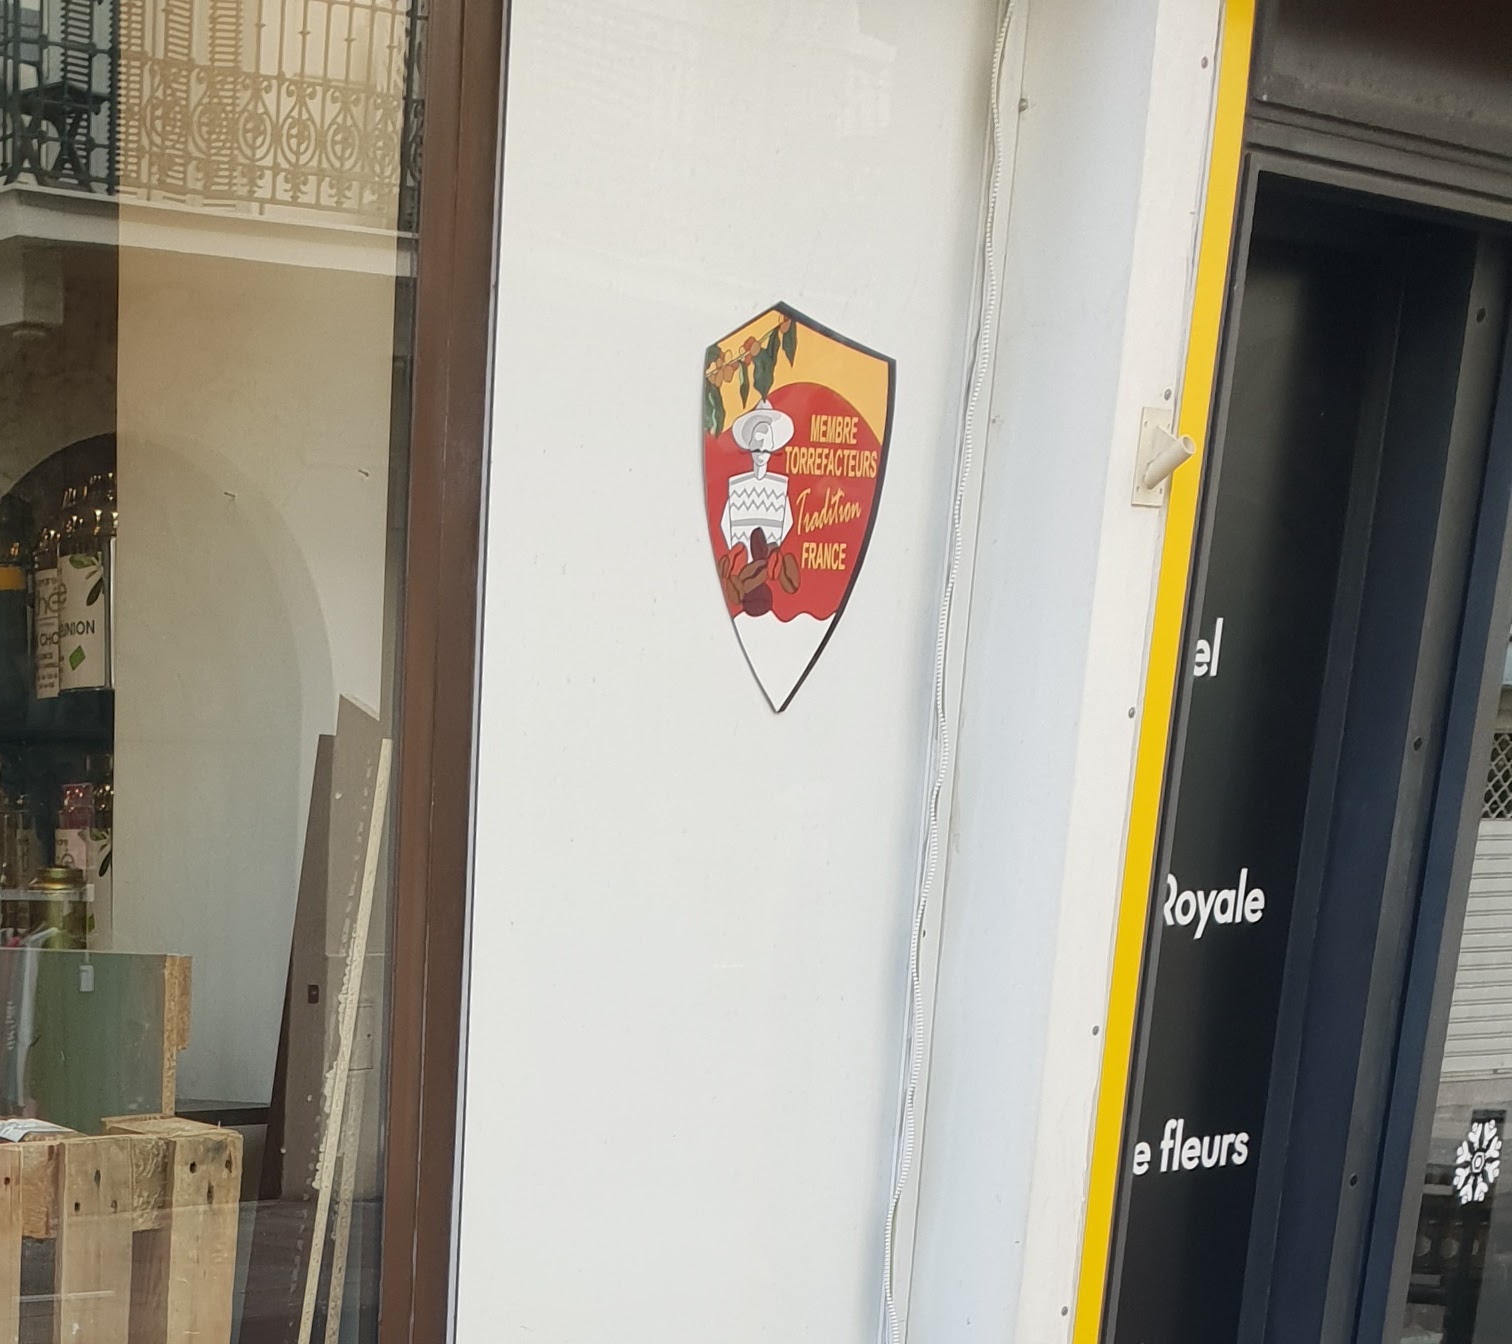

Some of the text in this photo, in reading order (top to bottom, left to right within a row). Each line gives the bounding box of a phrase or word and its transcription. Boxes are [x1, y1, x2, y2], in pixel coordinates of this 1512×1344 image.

[810, 414, 859, 445] MEMBRE
[785, 446, 878, 478] TORREFACTEURS
[796, 487, 862, 536] Tradition
[801, 542, 847, 570] FRANCE
[1160, 1118, 1250, 1173] fleurs
